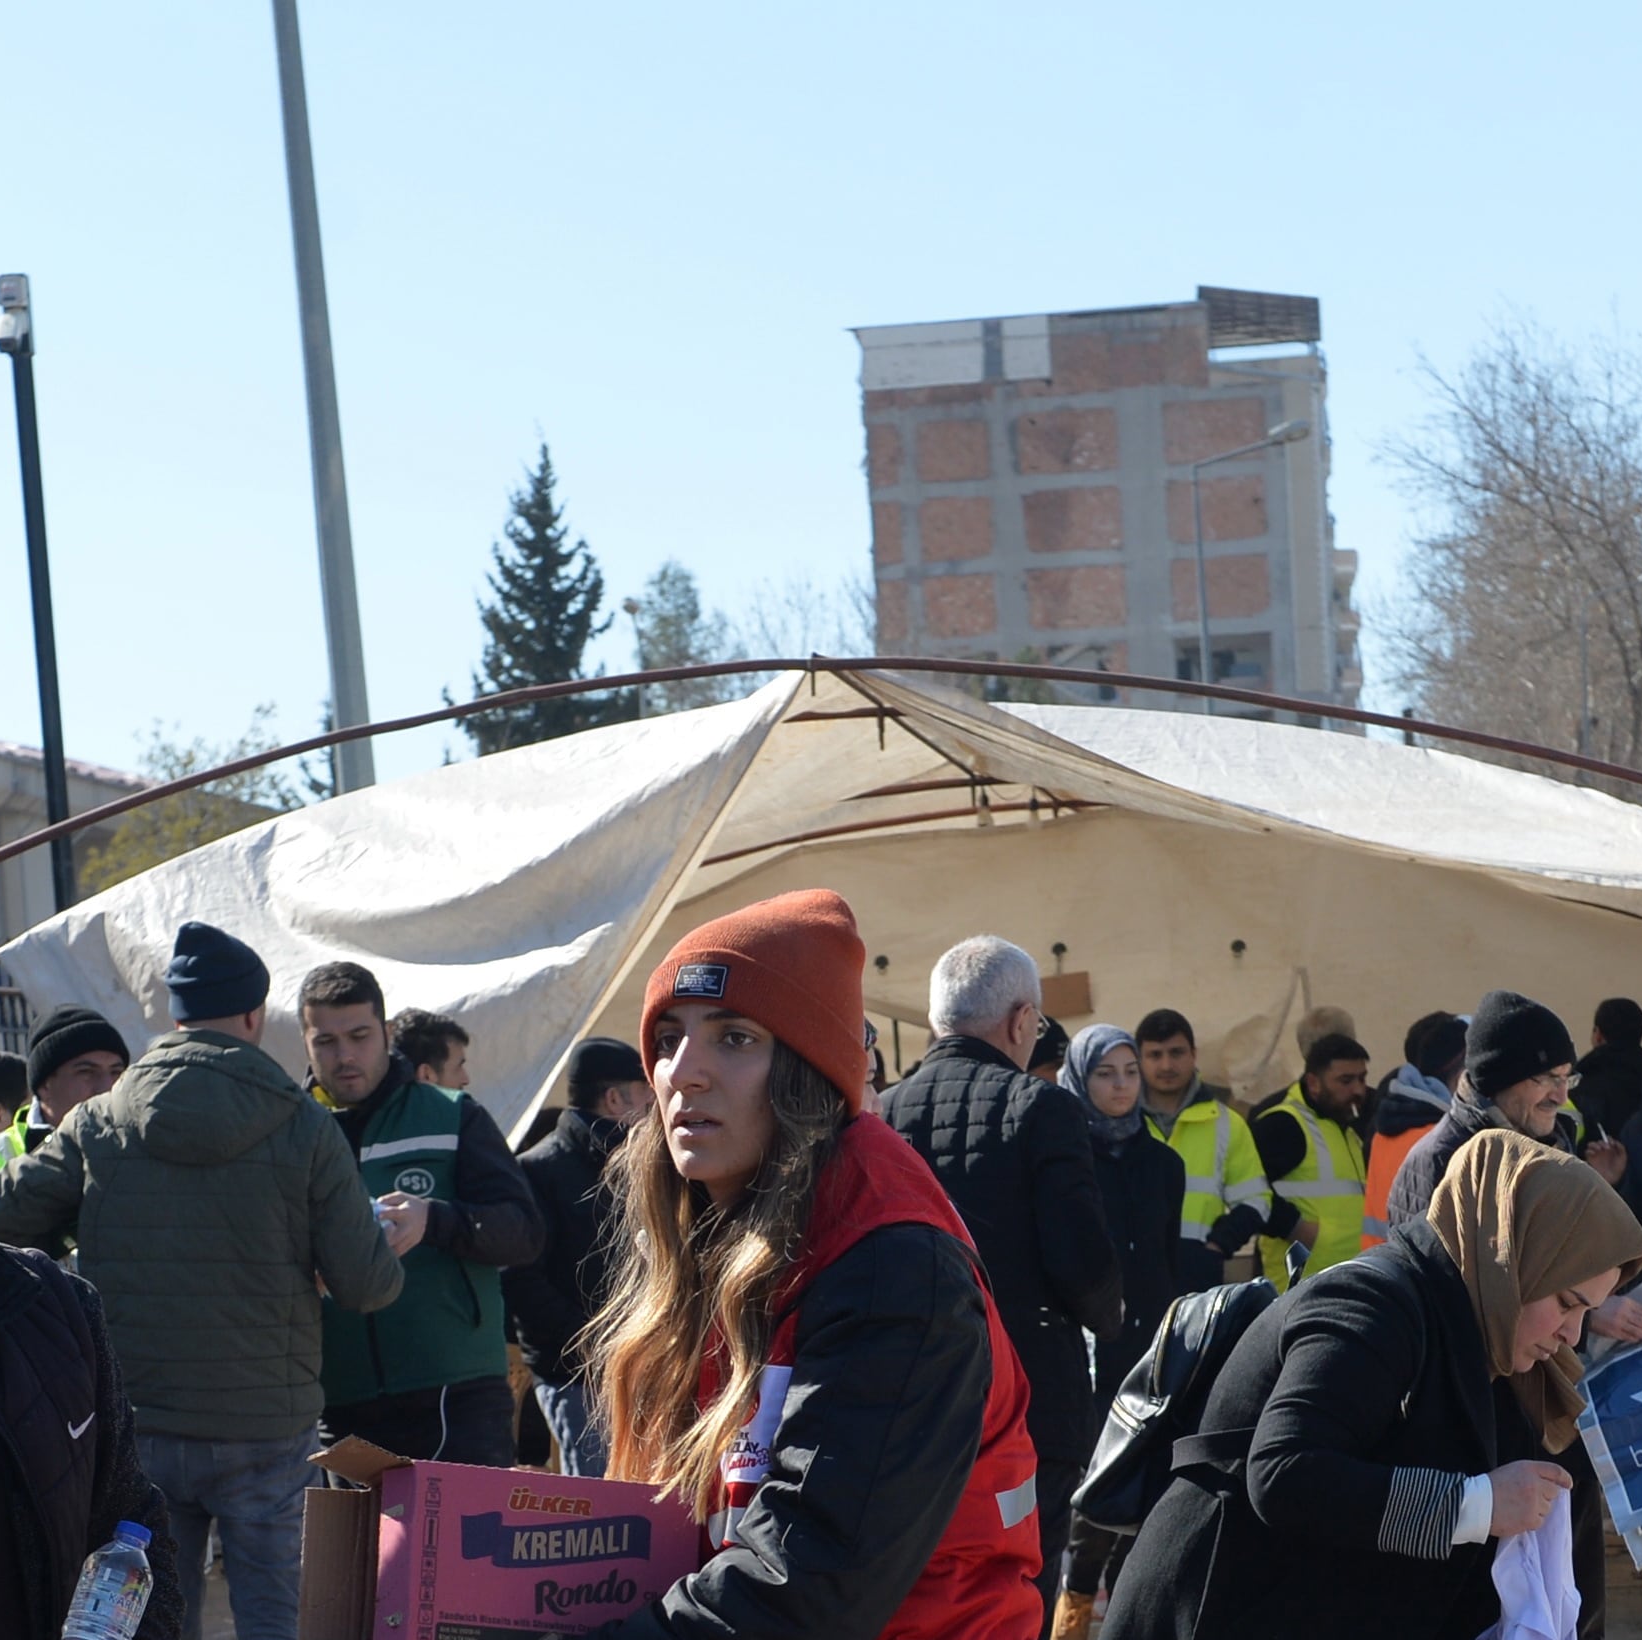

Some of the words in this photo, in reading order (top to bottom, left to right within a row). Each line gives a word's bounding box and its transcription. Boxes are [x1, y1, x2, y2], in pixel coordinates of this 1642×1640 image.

[508, 1487, 593, 1518] ÜLKER
[512, 1523, 629, 1560] KREMALI
[534, 1569, 637, 1616] Rondo
[438, 1611, 478, 1624] Sandwich
[479, 1614, 512, 1626] Biscuits
[513, 1617, 531, 1628] with
[532, 1618, 575, 1633] Strawberry
